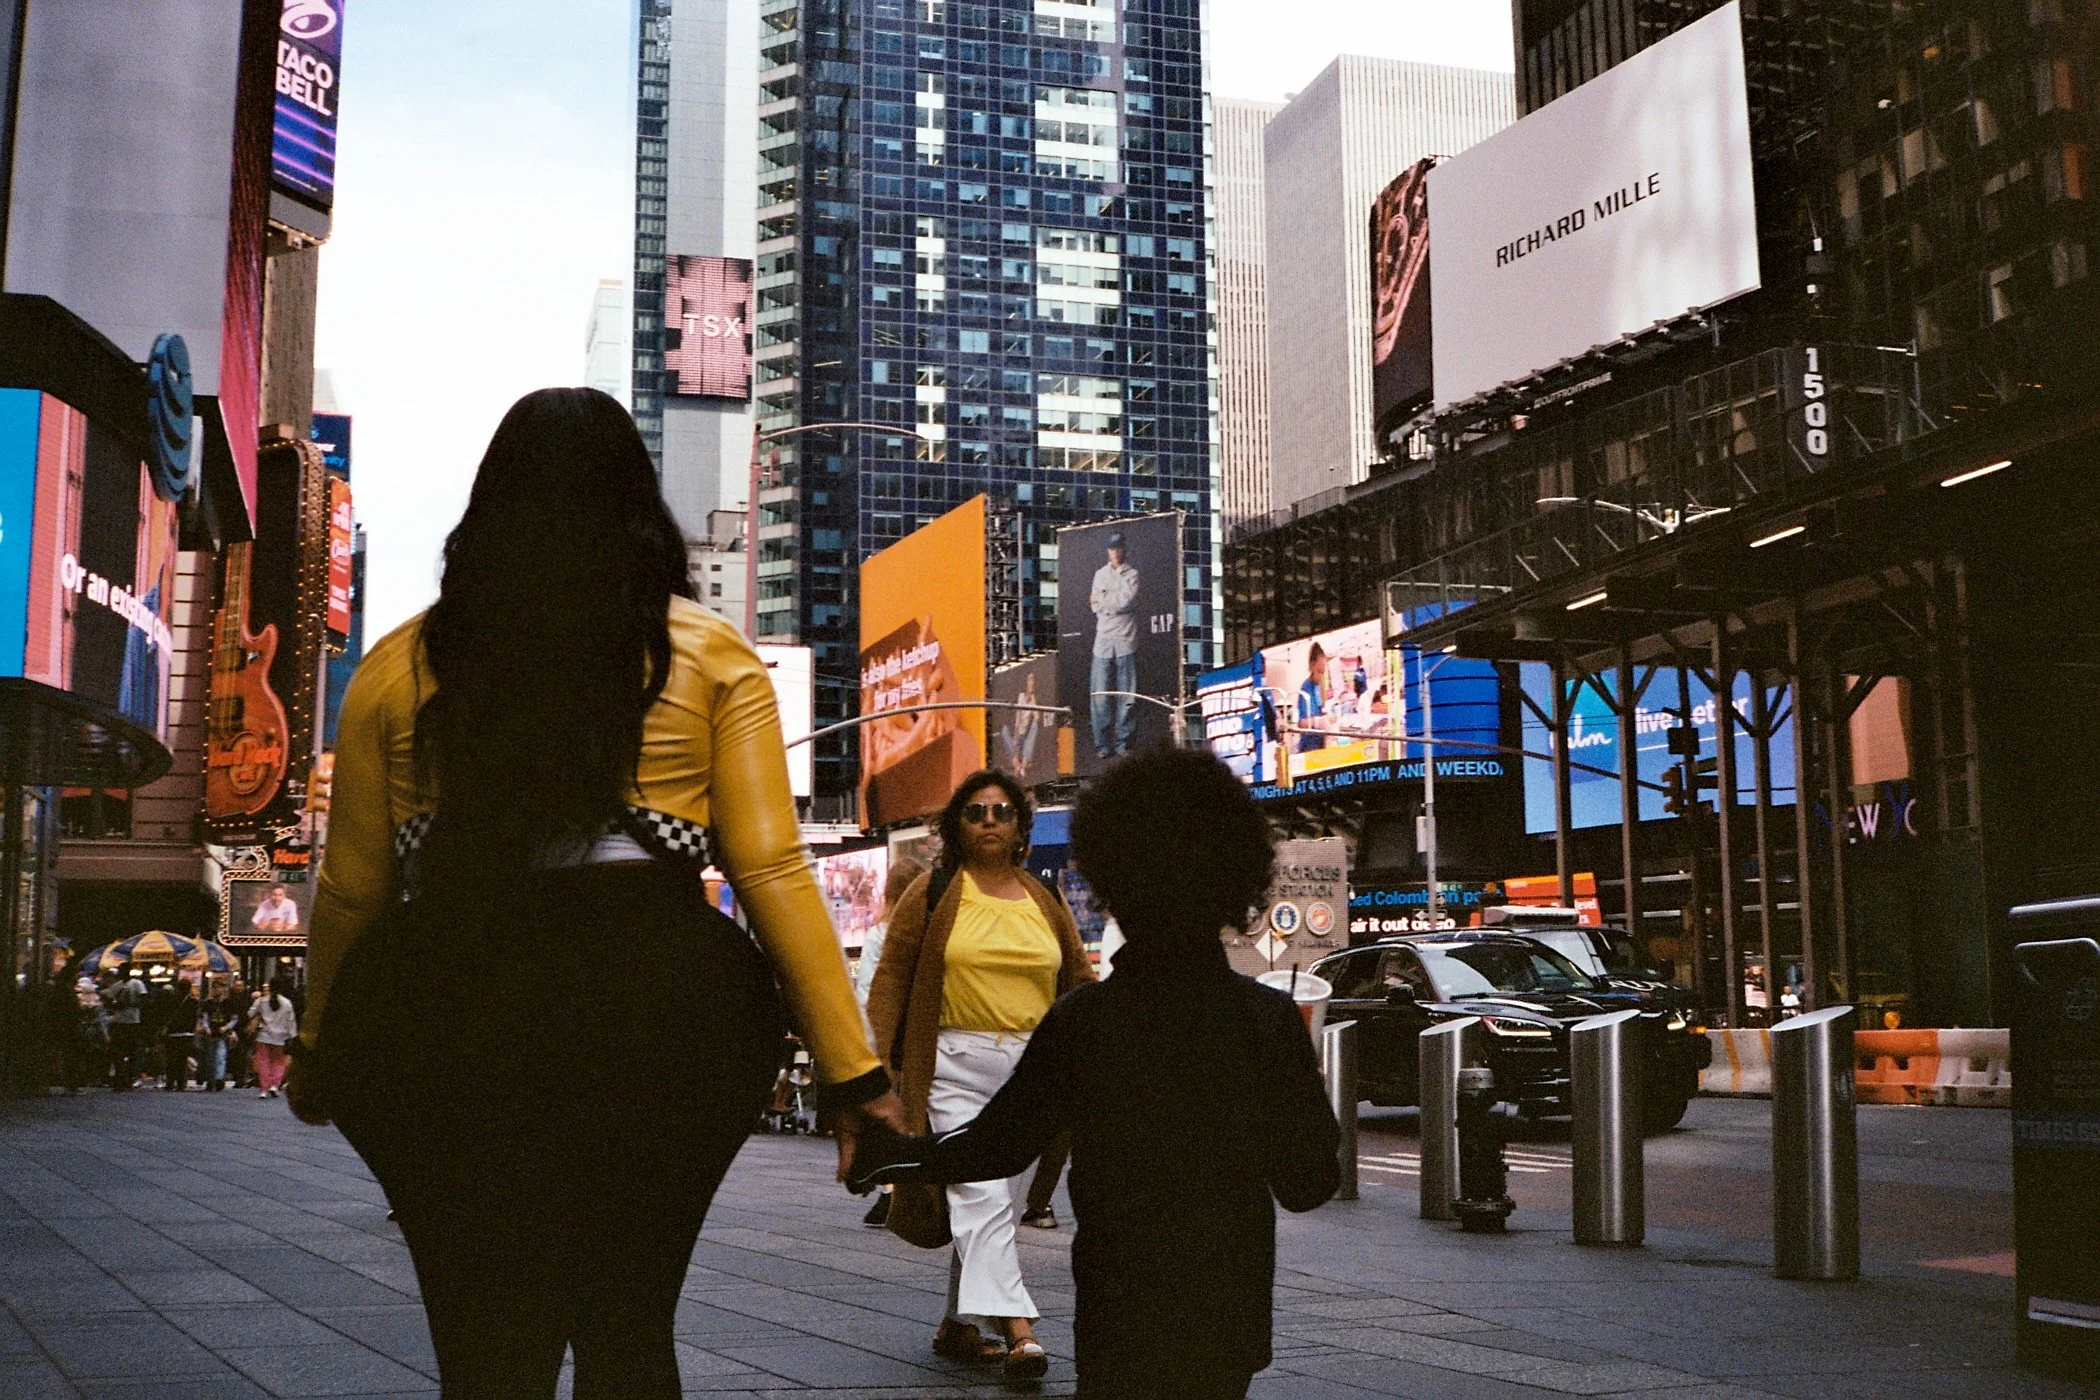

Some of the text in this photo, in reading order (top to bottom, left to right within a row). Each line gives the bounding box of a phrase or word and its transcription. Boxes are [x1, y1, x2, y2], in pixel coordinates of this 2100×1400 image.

[277, 40, 333, 89] TACO
[276, 66, 332, 116] BELL
[1496, 172, 1661, 268] RICHARD MILLE
[683, 313, 742, 338] TSX
[1803, 347, 1828, 455] 1500
[61, 553, 87, 593] Or
[87, 573, 109, 606] an
[1151, 613, 1174, 634] GAP
[1634, 706, 1673, 734] live
[1356, 766, 1391, 783] 11PM
[1351, 918, 1368, 933] air
[1369, 916, 1381, 932] it
[1382, 917, 1409, 931] out
